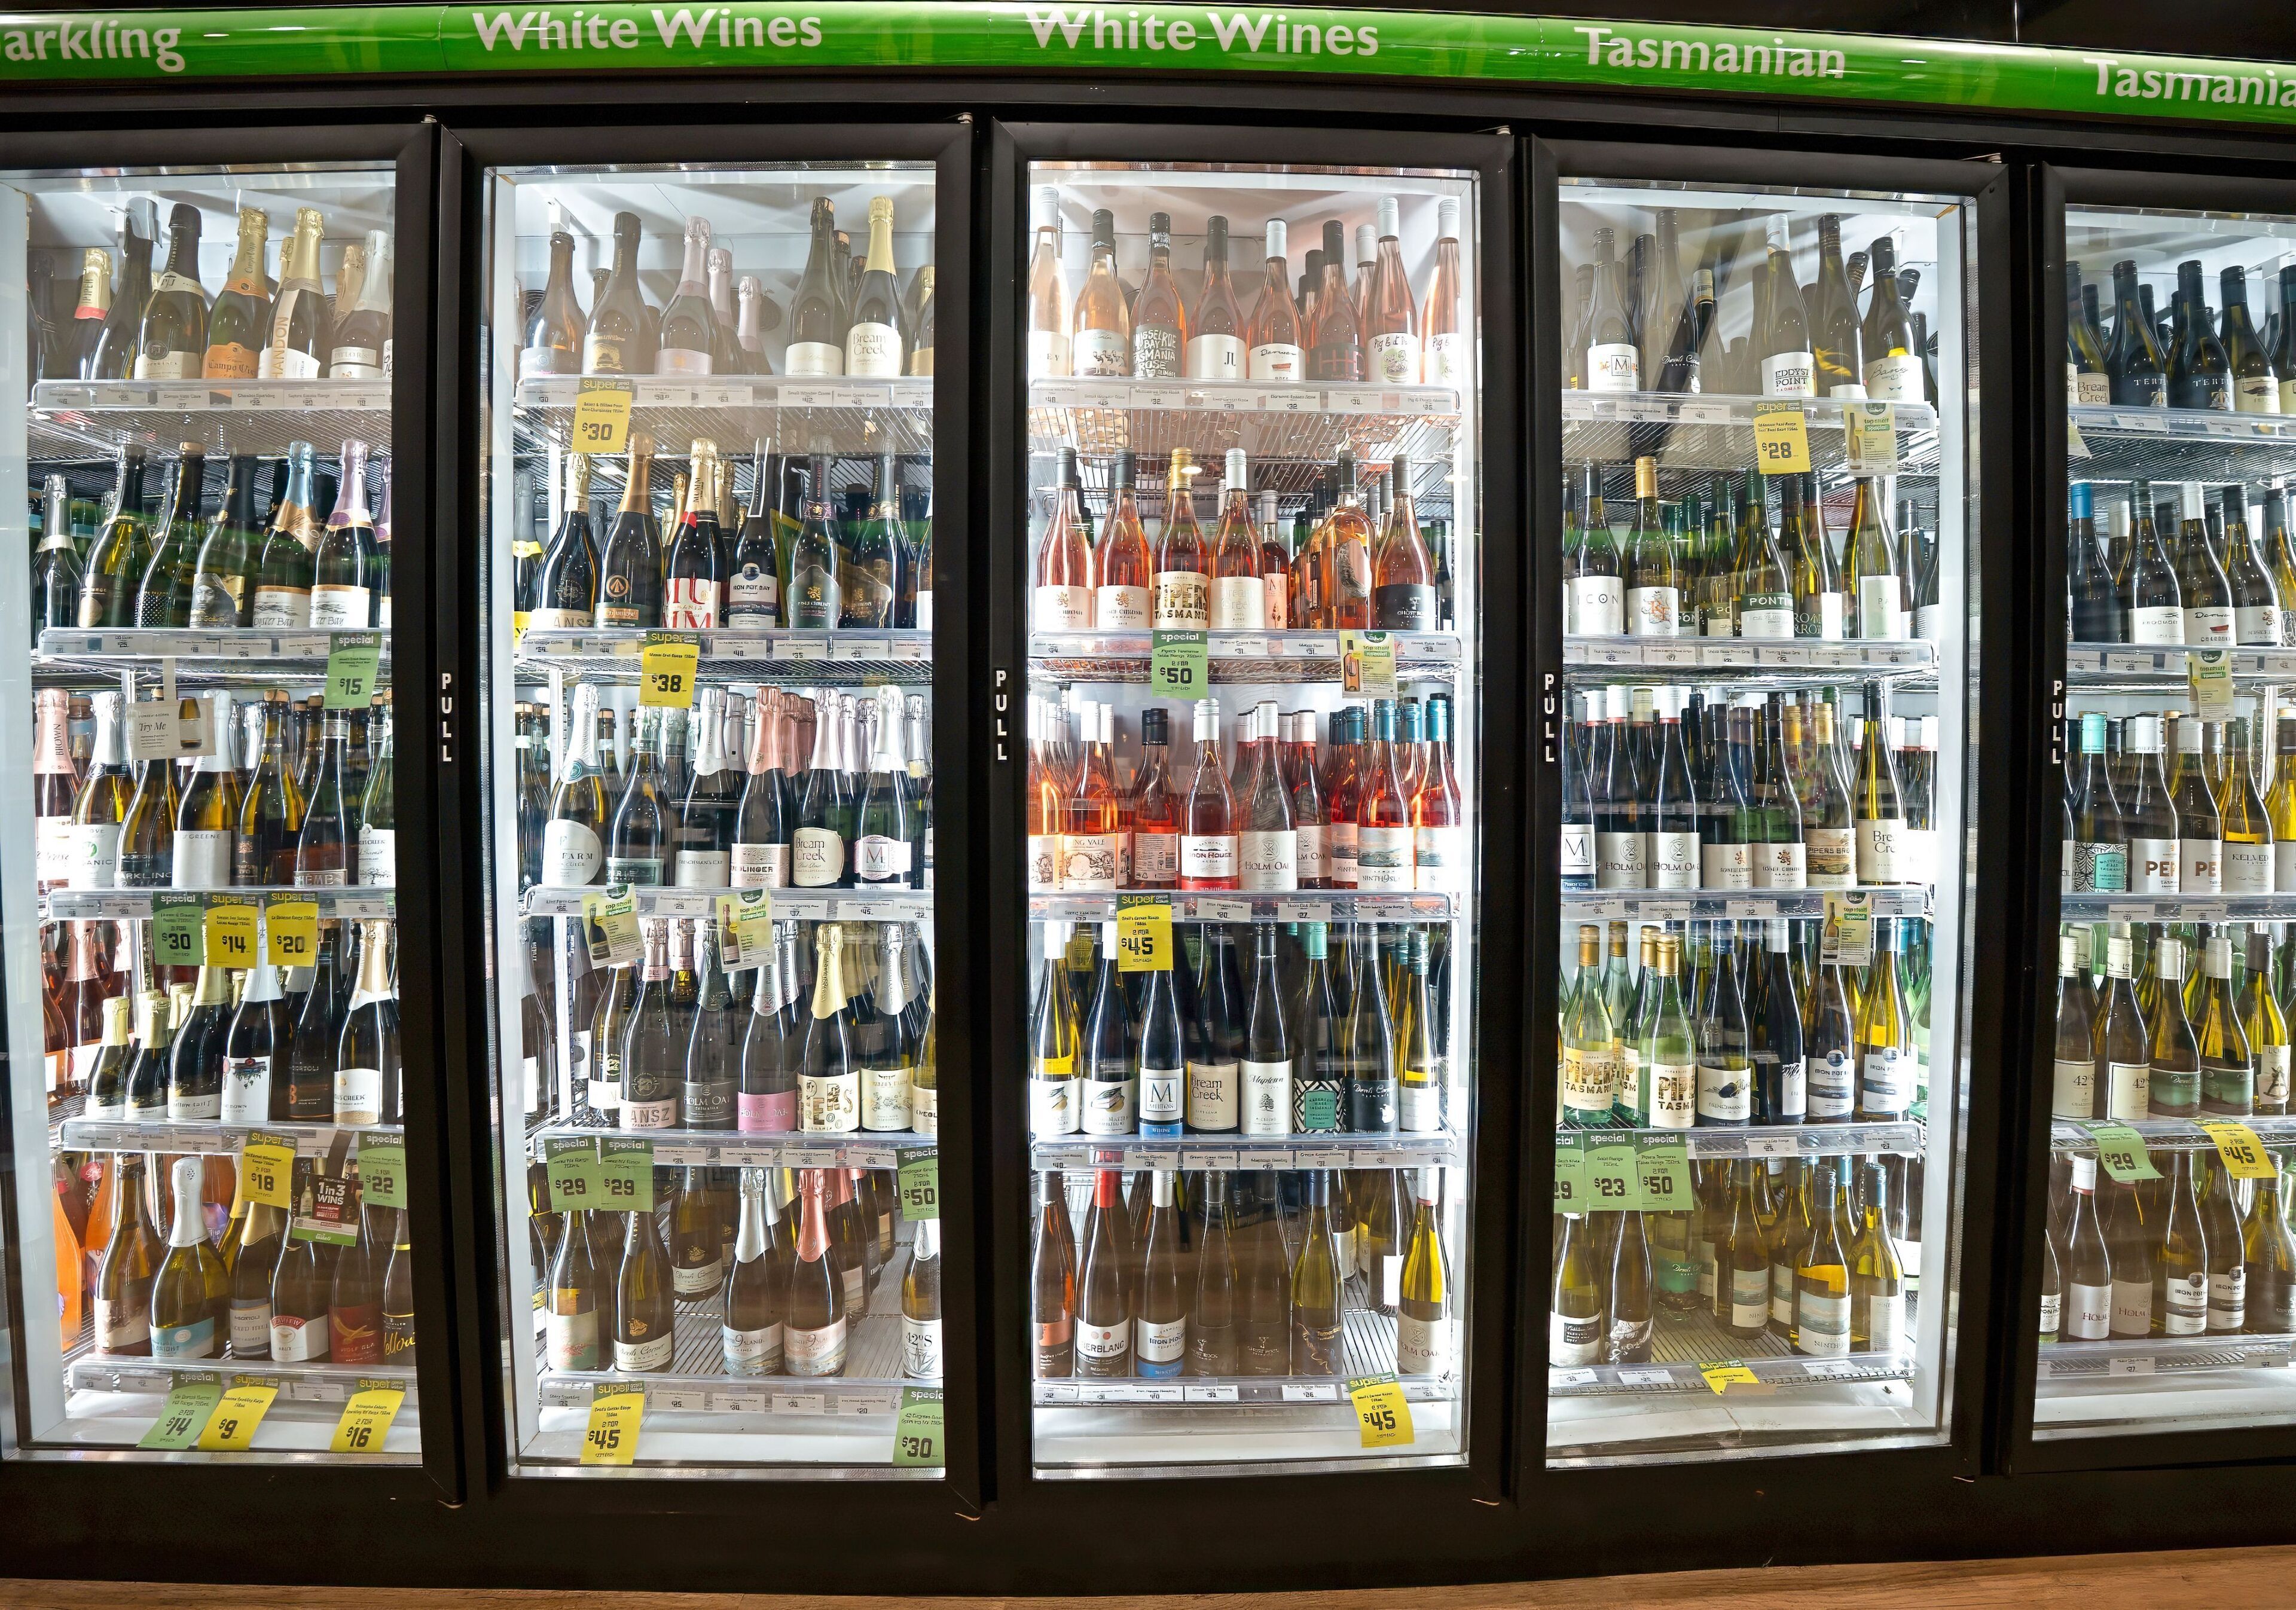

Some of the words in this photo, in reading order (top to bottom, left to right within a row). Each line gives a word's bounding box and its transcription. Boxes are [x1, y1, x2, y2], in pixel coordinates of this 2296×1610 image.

[472, 11, 638, 52] White
[652, 10, 822, 48] Wines
[1027, 10, 1195, 50] White
[1207, 11, 1379, 57] Wines
[4, 19, 186, 73] arkling
[1575, 28, 1846, 80] Tasmanian
[2086, 57, 2296, 108] Tasmania
[853, 332, 886, 345] Bream
[1373, 337, 1383, 352] Pig
[853, 344, 886, 356] Creek
[584, 380, 616, 391] super
[1776, 377, 1807, 387] POINT
[2077, 381, 2109, 392] Bream
[1757, 402, 1786, 413] super
[582, 423, 612, 441] $30
[1761, 442, 1791, 459] $28
[1578, 594, 1620, 605] ICON
[338, 636, 374, 646] special
[651, 631, 683, 644] super
[1161, 634, 1199, 643] special
[1159, 667, 1192, 685] $50
[339, 678, 364, 696] $15
[651, 674, 682, 693] $38
[441, 672, 453, 763] PULL
[996, 670, 1007, 761] PULL
[1544, 674, 1555, 762] PULL
[139, 722, 152, 734] Try
[153, 722, 167, 731] Me
[2052, 680, 2063, 765] PULL
[1873, 830, 1894, 842] Bre
[796, 838, 825, 849] Bream
[1874, 842, 1895, 853] Cre
[563, 852, 593, 860] FARM
[796, 849, 825, 862] Creek
[866, 845, 884, 863] M
[1245, 861, 1271, 870] HOLM
[1605, 861, 1633, 871] HOLM
[1653, 861, 1681, 871] HOLM
[160, 896, 196, 905] special
[212, 895, 242, 906] super
[271, 892, 301, 903] super
[1120, 895, 1154, 906] super
[162, 933, 191, 950] $30
[222, 936, 246, 953] $14
[277, 936, 306, 953] $20
[1121, 937, 1153, 955] $45
[1190, 1076, 1222, 1089] Bream
[1150, 1082, 1172, 1102] M
[1191, 1087, 1223, 1102] Creek
[251, 1132, 282, 1145] super
[367, 1135, 402, 1145] special
[553, 1139, 588, 1151] special
[1556, 1136, 1574, 1145] cial
[1590, 1135, 1626, 1145] special
[1642, 1135, 1678, 1145] special
[608, 1141, 645, 1150] special
[903, 1148, 937, 1159] specia
[2224, 1145, 2256, 1164] $45
[2105, 1153, 2136, 1171] $29
[251, 1174, 274, 1191] $18
[366, 1176, 393, 1194] $22
[555, 1178, 586, 1195] $29
[604, 1179, 634, 1195] $29
[1593, 1178, 1625, 1196] $23
[1642, 1176, 1673, 1194] $50
[317, 1194, 344, 1205] WINS
[903, 1189, 935, 1205] $50
[1401, 1343, 1418, 1355] OLM
[180, 1373, 214, 1383] special
[359, 1378, 390, 1390] super
[597, 1384, 628, 1394] super
[910, 1389, 943, 1400] specia
[166, 1416, 190, 1436] $14
[1363, 1410, 1396, 1430] $45
[219, 1419, 237, 1439] $9
[346, 1426, 370, 1447] $16
[588, 1429, 619, 1449] $45
[901, 1436, 932, 1458] $30
